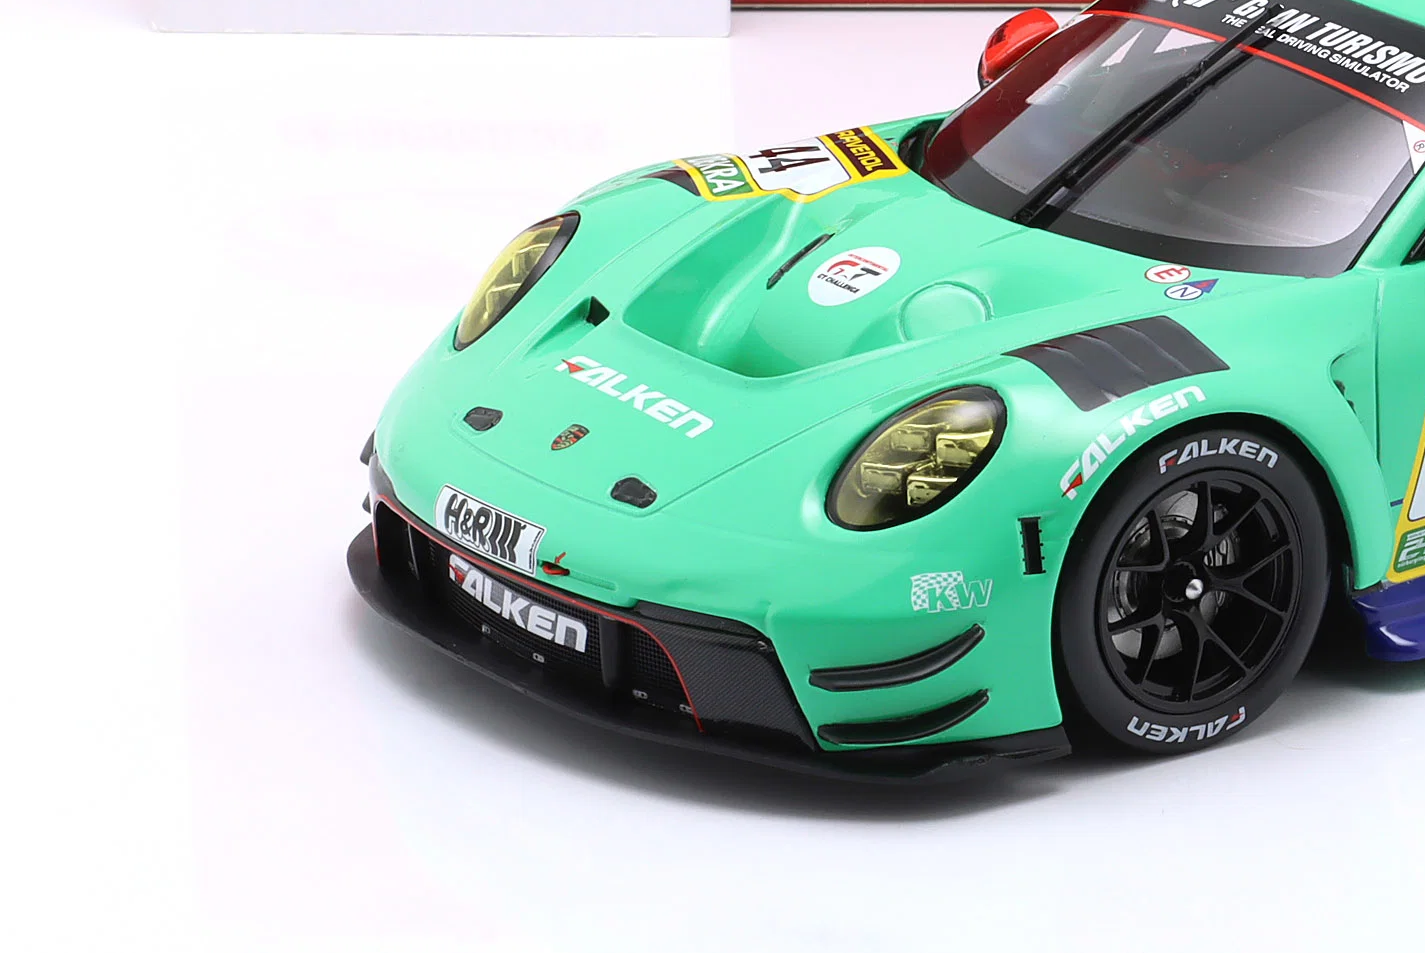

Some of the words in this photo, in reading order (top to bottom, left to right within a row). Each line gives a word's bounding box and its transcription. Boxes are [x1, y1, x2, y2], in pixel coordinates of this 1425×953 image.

[1221, 14, 1248, 28] THE
[1276, 33, 1331, 59] DRIVING
[1329, 52, 1410, 94] SIMULATOR
[748, 146, 831, 174] 44
[834, 129, 883, 171] RAVENOL
[554, 355, 714, 438] FALKEN
[1059, 385, 1207, 501] FALKEN
[1158, 438, 1280, 474] FALKEN
[448, 554, 588, 652] FALKEN
[927, 578, 994, 612] KW
[1127, 706, 1246, 744] FALKEN
